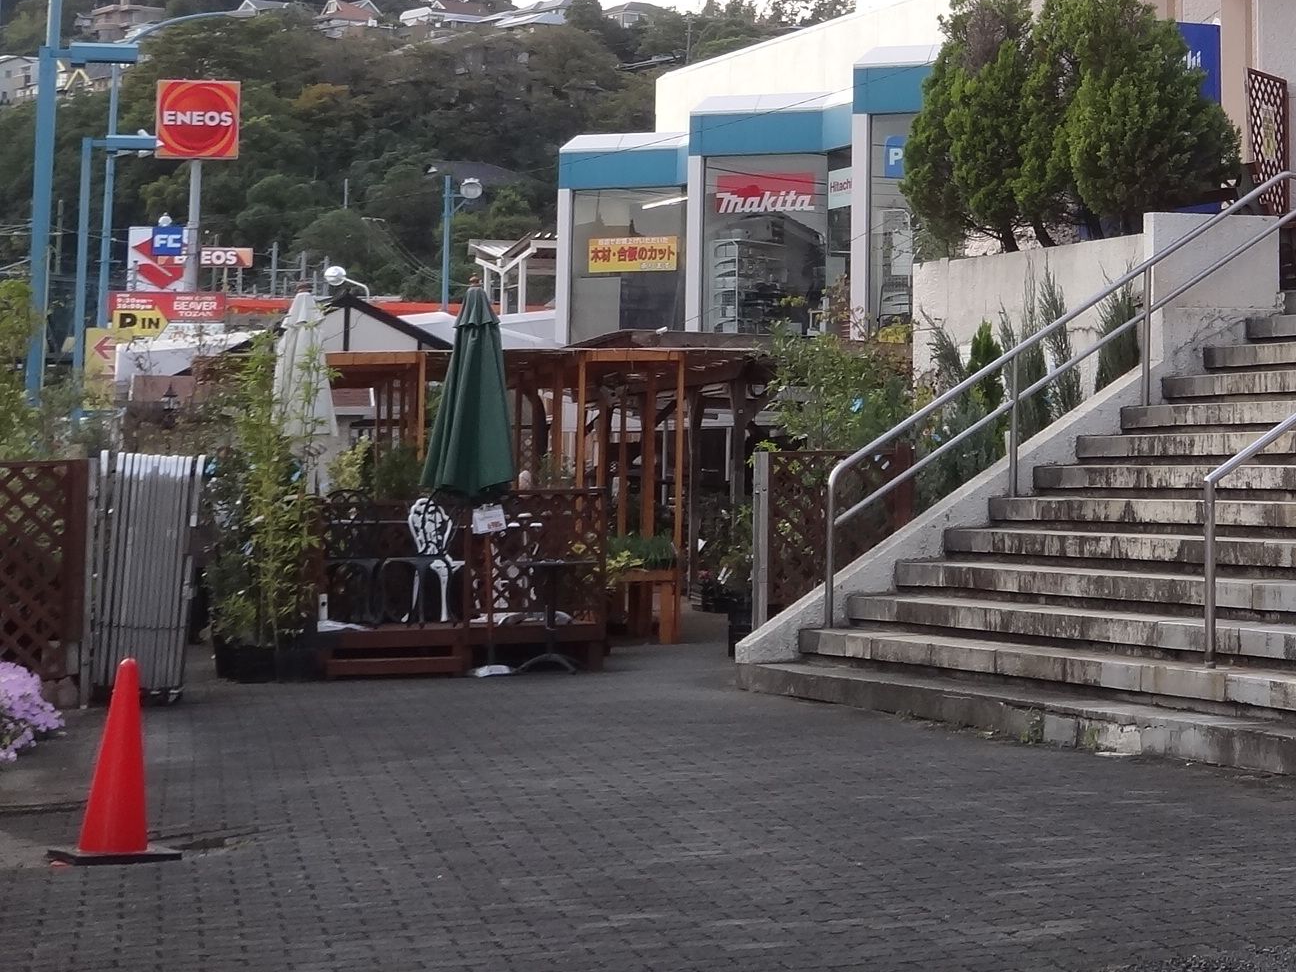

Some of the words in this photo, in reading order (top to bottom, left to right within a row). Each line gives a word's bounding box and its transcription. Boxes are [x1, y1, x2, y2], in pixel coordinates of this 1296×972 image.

[163, 111, 233, 126] ENEOS
[173, 301, 217, 310] BEAVER
[141, 317, 160, 329] IN
